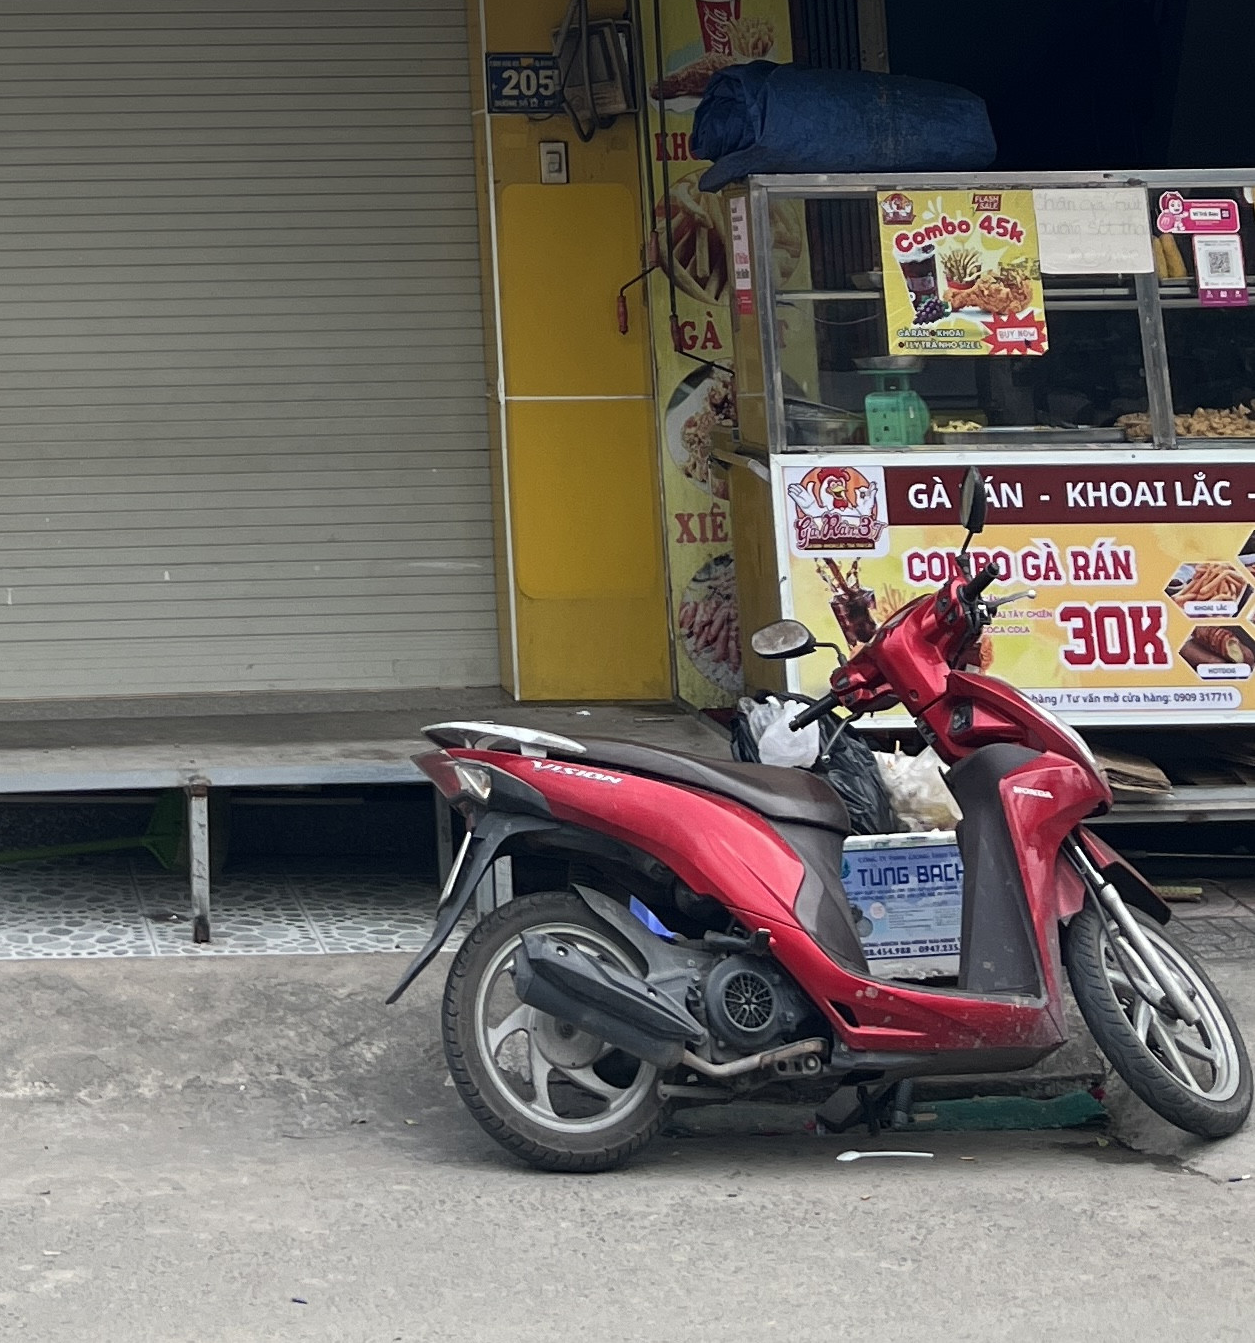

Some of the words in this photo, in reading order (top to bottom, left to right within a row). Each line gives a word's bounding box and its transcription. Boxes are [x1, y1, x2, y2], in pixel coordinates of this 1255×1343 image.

[501, 69, 557, 97] 205
[974, 195, 999, 203] FLASH
[978, 202, 999, 210] SALE
[895, 215, 971, 253] Combo
[937, 329, 964, 337] KHOAI
[998, 330, 1015, 340] BUY
[1017, 329, 1036, 339] NOW
[908, 474, 952, 509] GÀ
[978, 475, 1024, 509] ÁN
[1065, 480, 1167, 508] KHOAI
[1174, 470, 1233, 507] LẮC
[674, 502, 729, 544] XIÊ
[1021, 542, 1063, 581] GÀ
[1073, 541, 1134, 581] RÁN
[1007, 626, 1030, 634] COLA
[1060, 606, 1169, 666] 30K
[1031, 693, 1058, 706] hàng
[1143, 692, 1172, 705] hàng:
[1173, 692, 1197, 703] 0909
[1199, 692, 1233, 702] 317711
[531, 760, 624, 785] VISION
[1012, 785, 1054, 799] HONDA
[857, 866, 910, 887] TUNG
